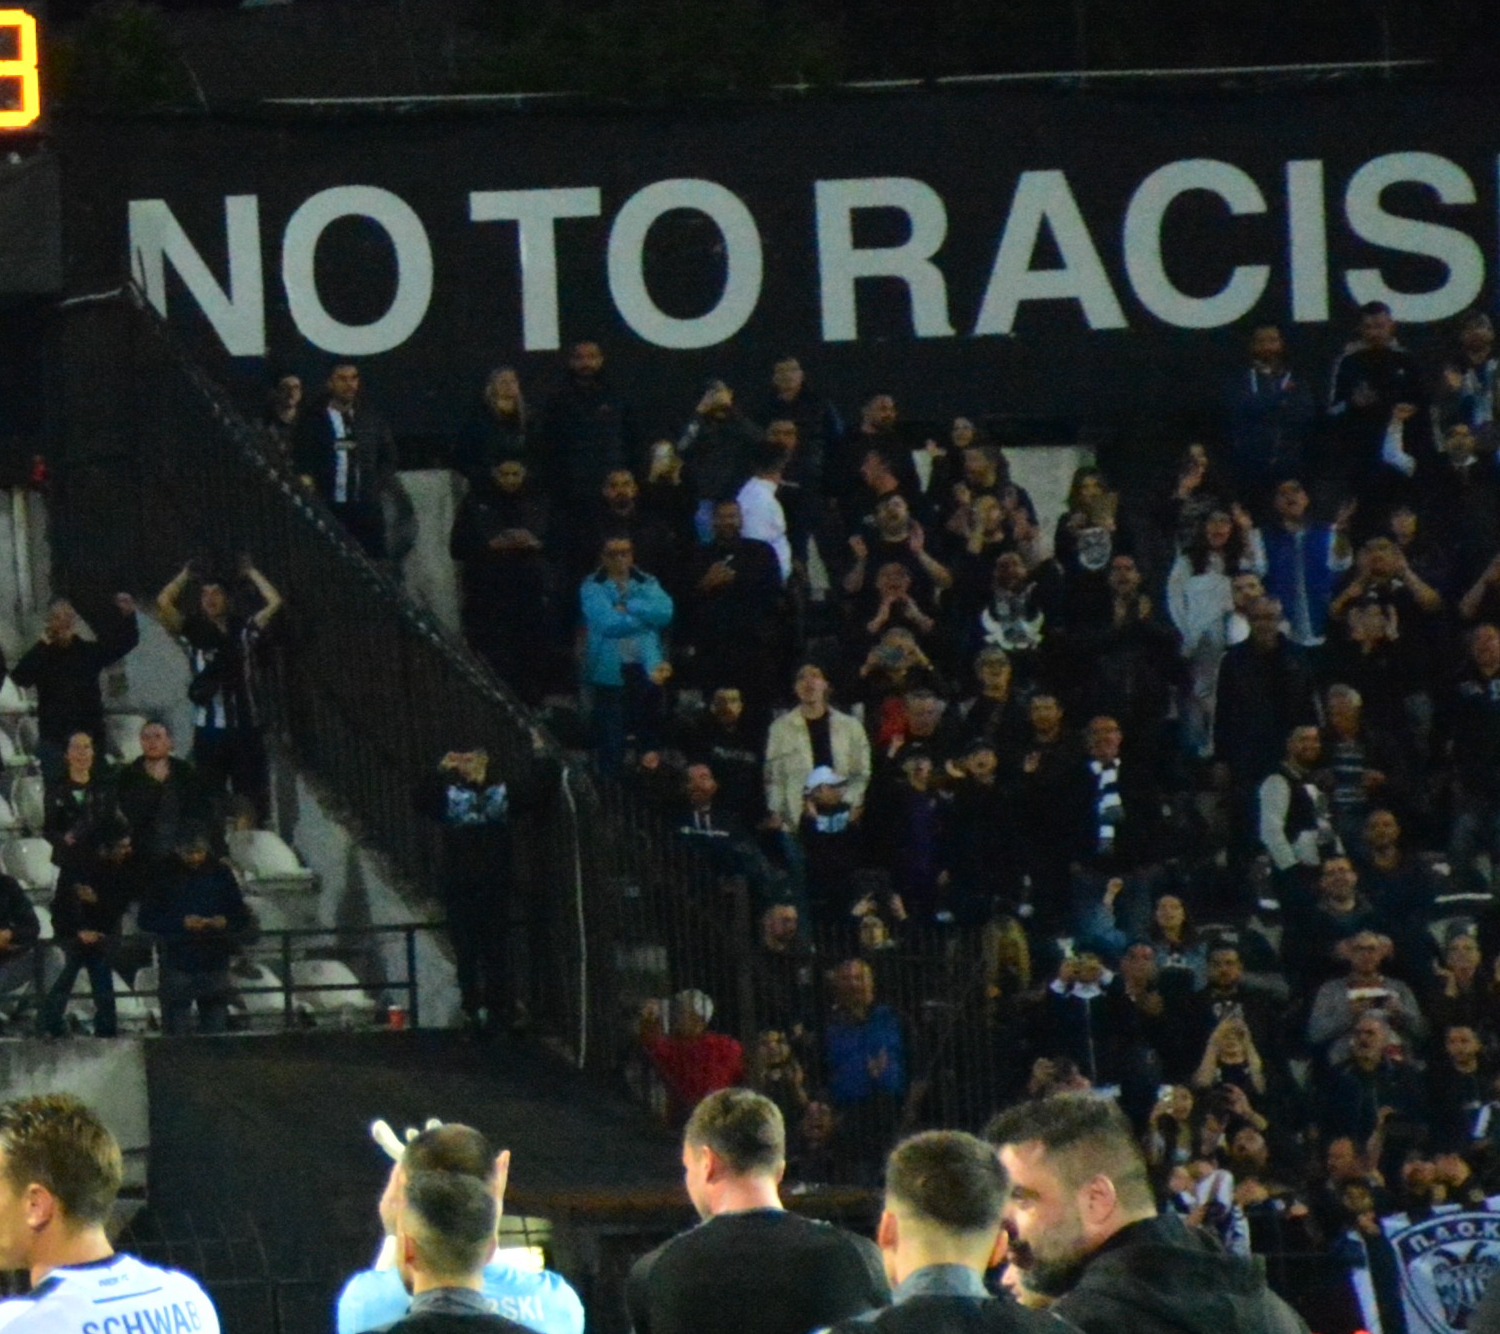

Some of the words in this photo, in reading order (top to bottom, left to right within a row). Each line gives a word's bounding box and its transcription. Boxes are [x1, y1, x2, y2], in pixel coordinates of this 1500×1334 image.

[126, 183, 435, 358] NO
[469, 177, 765, 351] TO
[811, 150, 1500, 342] RACIS
